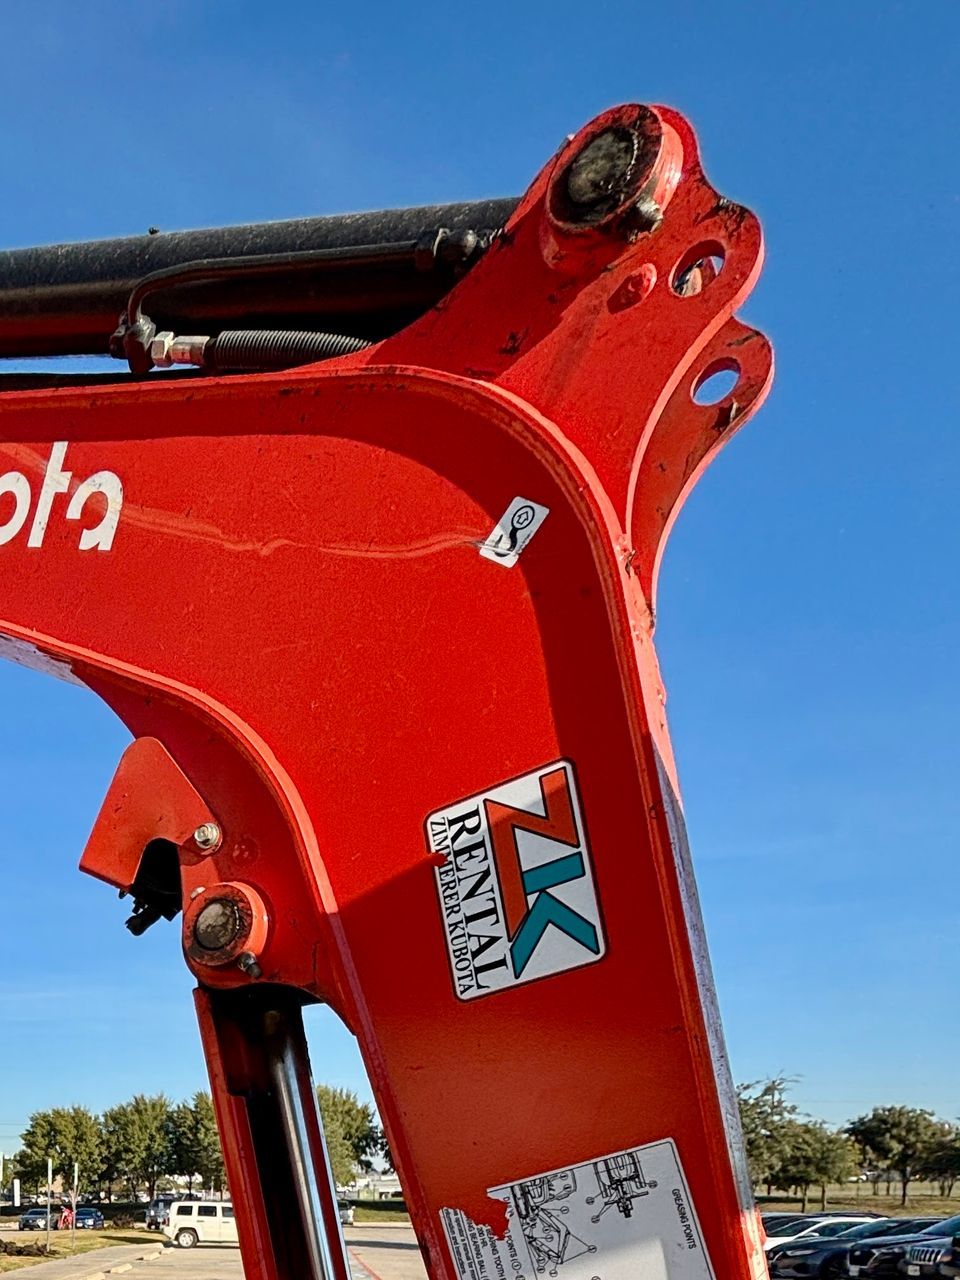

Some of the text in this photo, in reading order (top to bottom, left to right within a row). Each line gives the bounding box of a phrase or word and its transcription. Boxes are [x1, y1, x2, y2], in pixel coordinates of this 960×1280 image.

[447, 805, 508, 990] RENTAL
[449, 914, 475, 995] KUBOTA
[672, 1188, 696, 1249] GREASING POINTS
[469, 1231, 483, 1259] BEARING
[494, 1255, 505, 1277] TOOTH
[505, 1234, 518, 1258] POINTS
